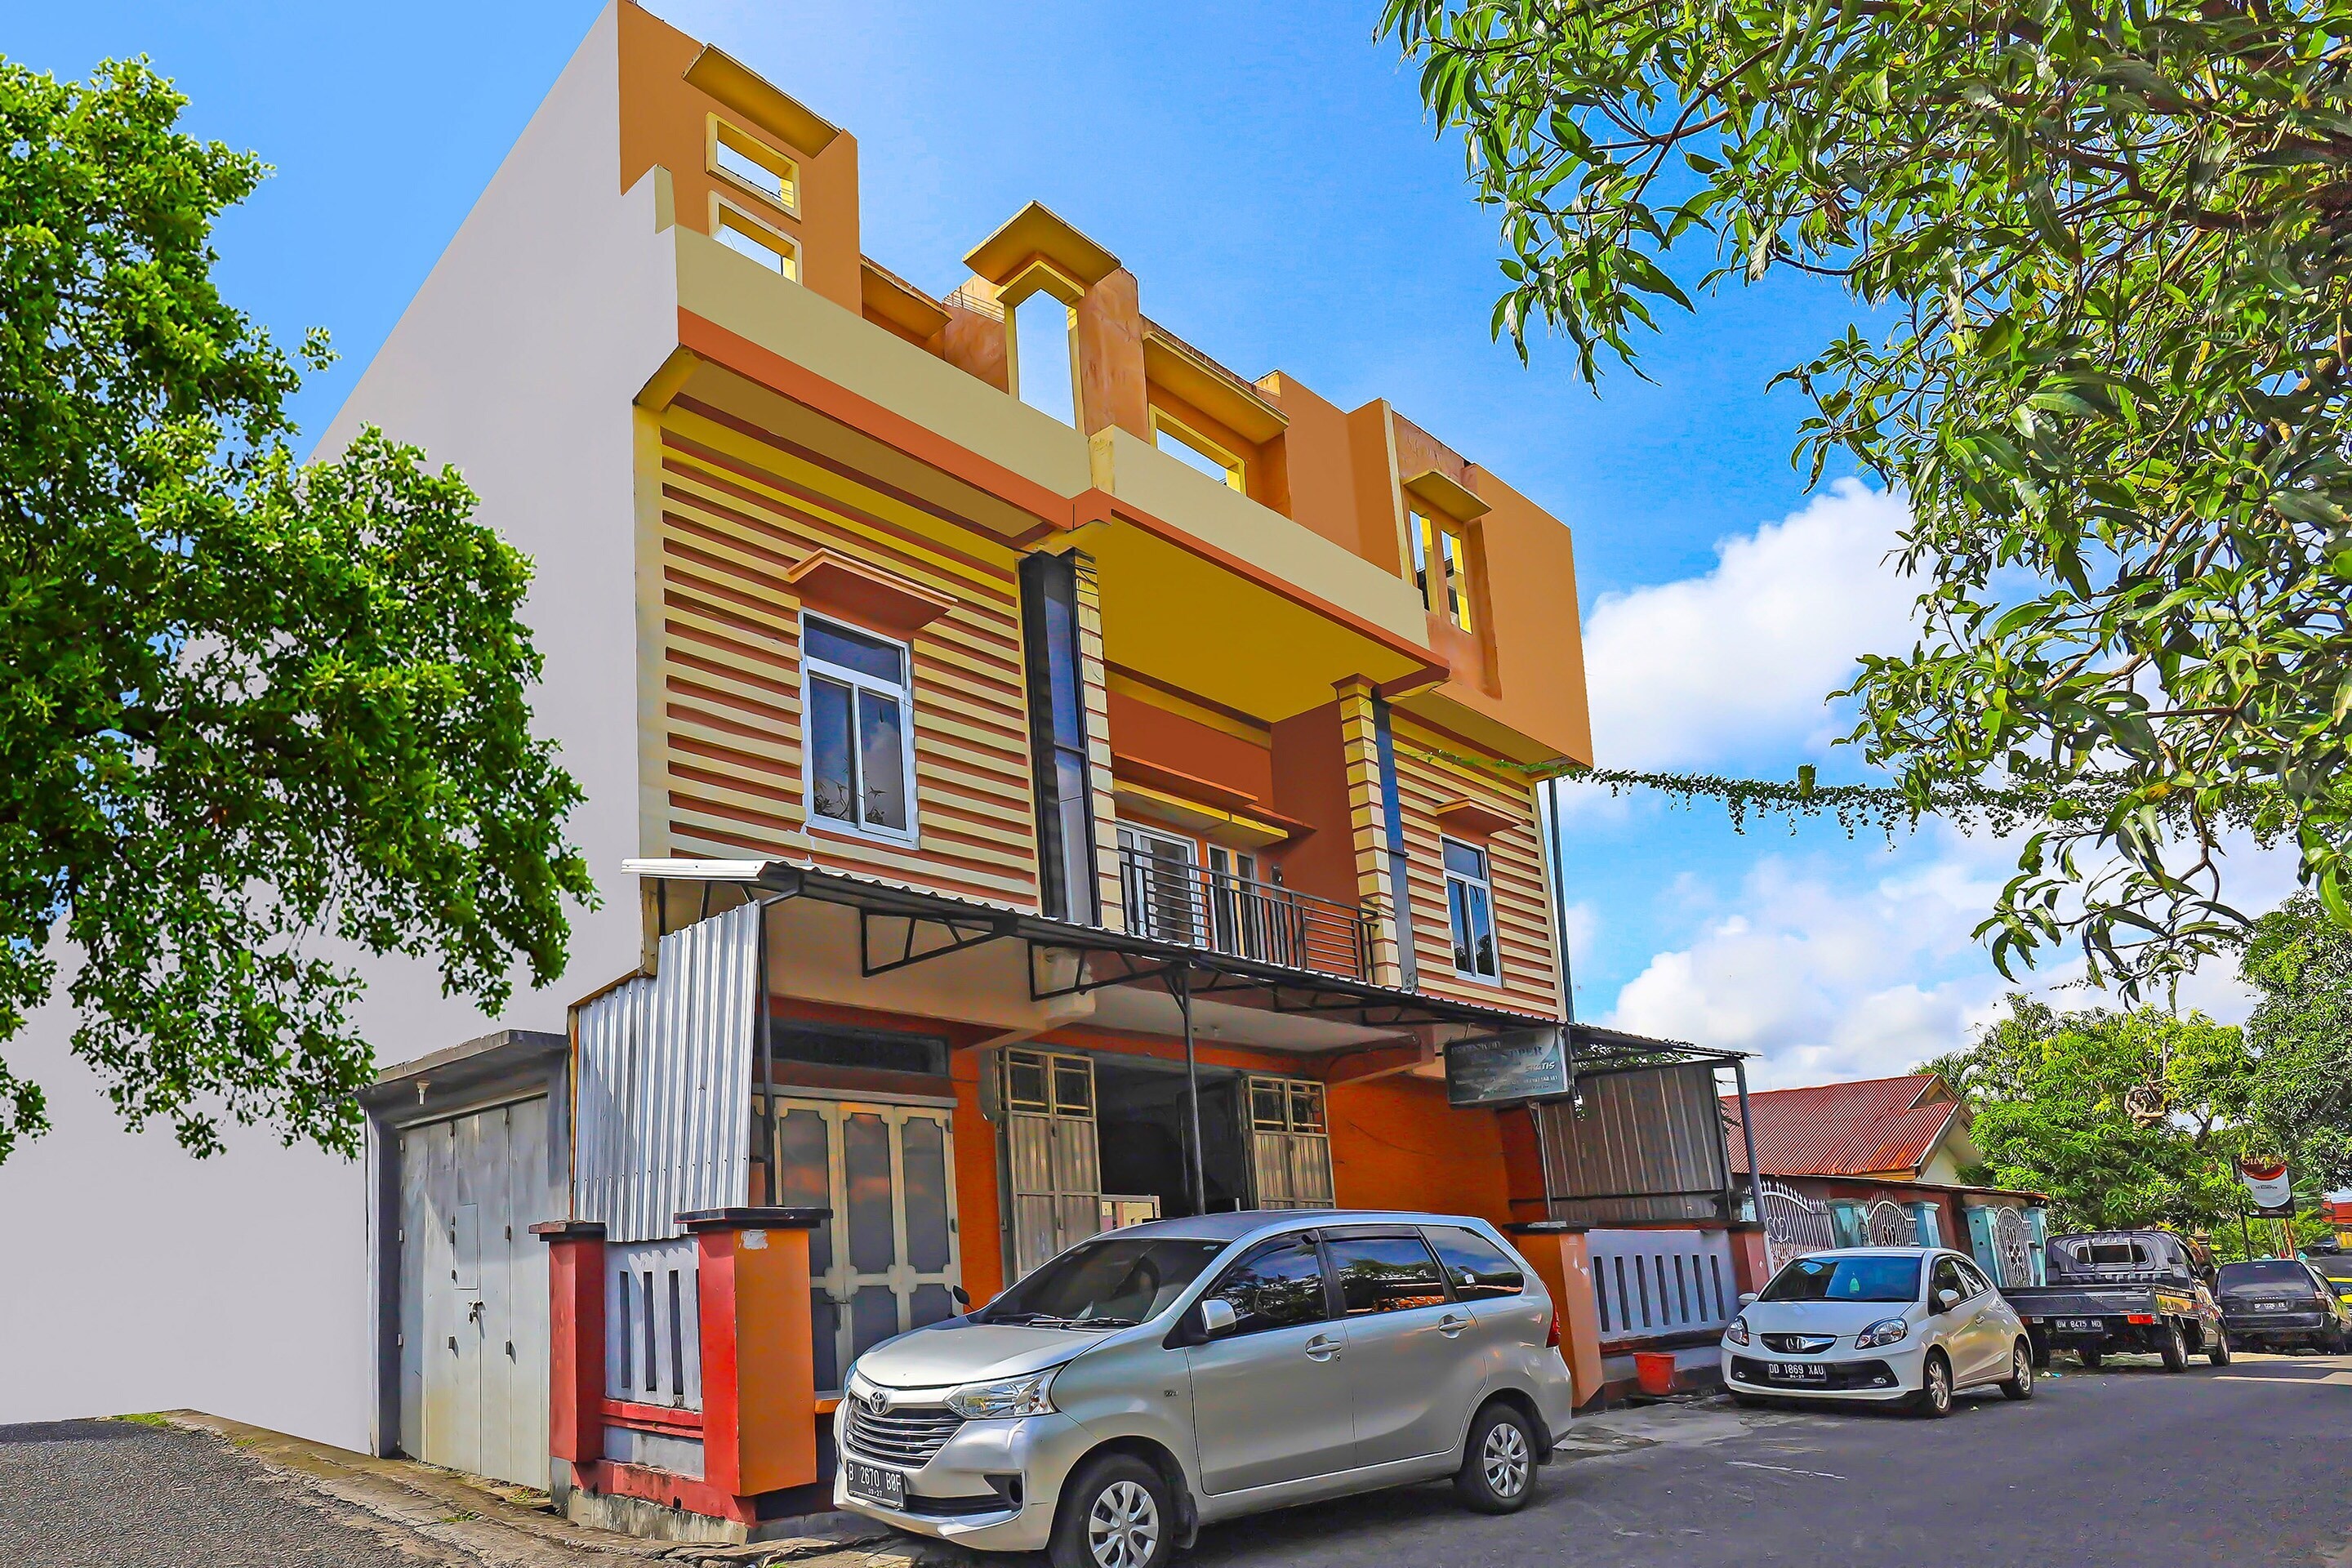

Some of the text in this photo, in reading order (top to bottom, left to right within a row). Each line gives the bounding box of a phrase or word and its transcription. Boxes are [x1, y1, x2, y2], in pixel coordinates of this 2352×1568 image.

[1768, 1363, 1824, 1375] DD 1869 XAU
[849, 1463, 854, 1481] B
[860, 1466, 880, 1487] 2670
